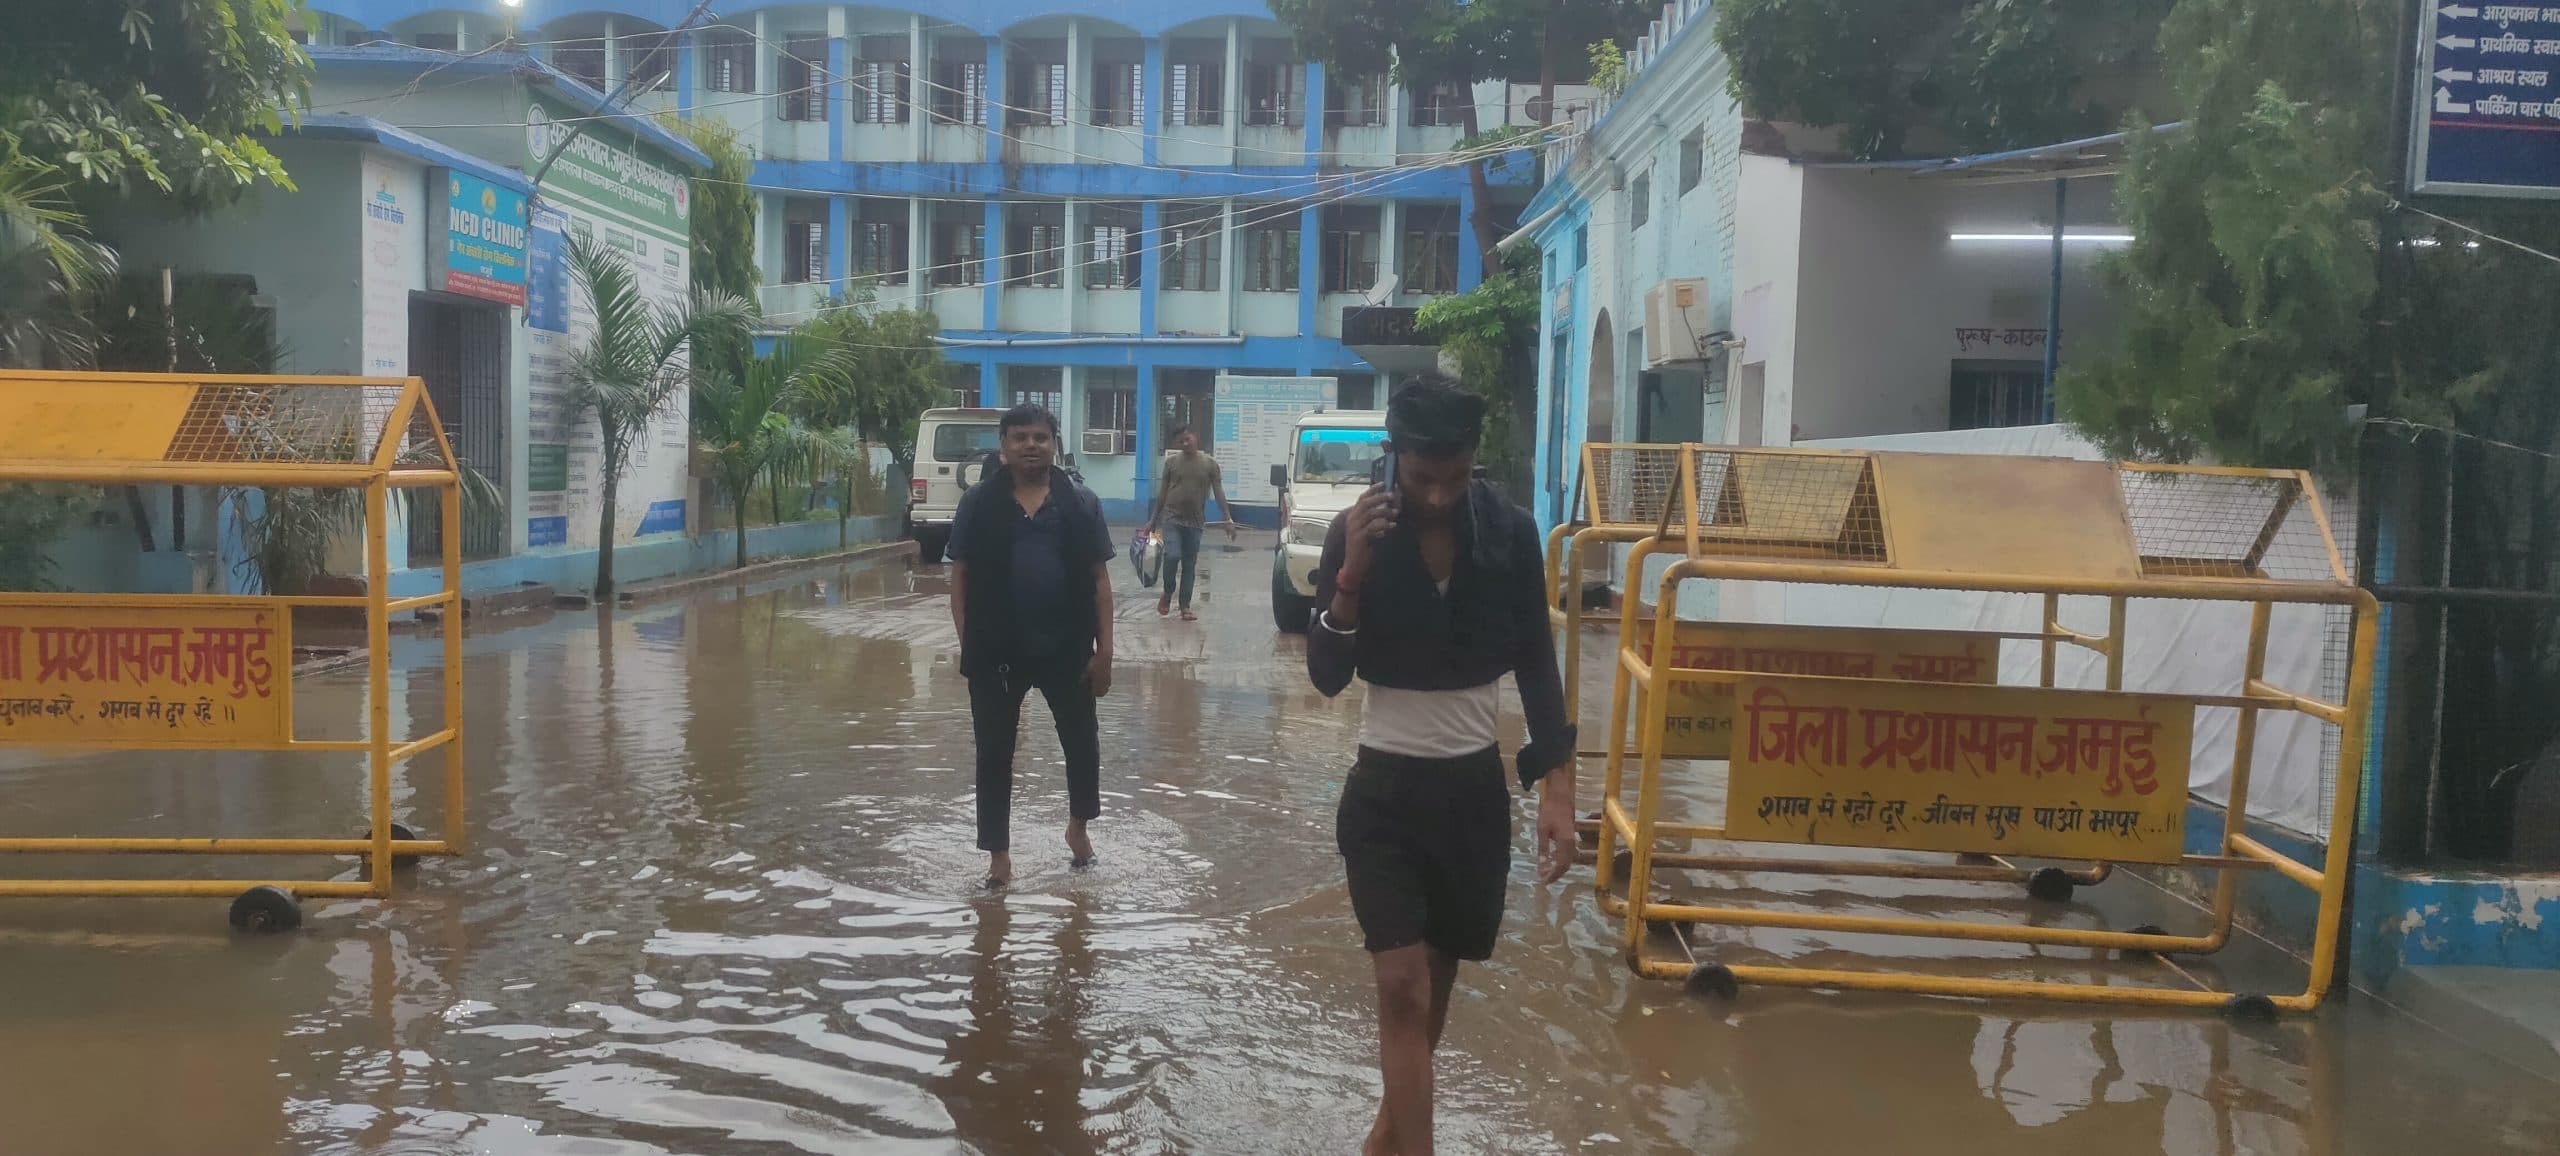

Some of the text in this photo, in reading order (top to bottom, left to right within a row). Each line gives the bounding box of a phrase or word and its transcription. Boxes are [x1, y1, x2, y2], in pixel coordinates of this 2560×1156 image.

[2482, 6, 2540, 29] आयुष्मान
[2480, 32, 2531, 54] प्राथमिक
[2477, 69, 2549, 87] आश्रय स्थल
[2475, 94, 2518, 116] पार्किंग
[2520, 102, 2543, 117] चार
[449, 206, 479, 238] NCD
[481, 216, 524, 250] CLINIC
[184, 613, 274, 698] जमुई
[98, 701, 143, 722] शराब
[146, 695, 161, 720] से
[1744, 686, 1850, 777] जिला
[2037, 704, 2162, 797] जमुई
[1758, 796, 1813, 826] शराब
[1817, 792, 1838, 819] से
[1842, 791, 1877, 825] रहो
[1920, 793, 1979, 828] जीवन
[2033, 800, 2085, 833] पाओ
